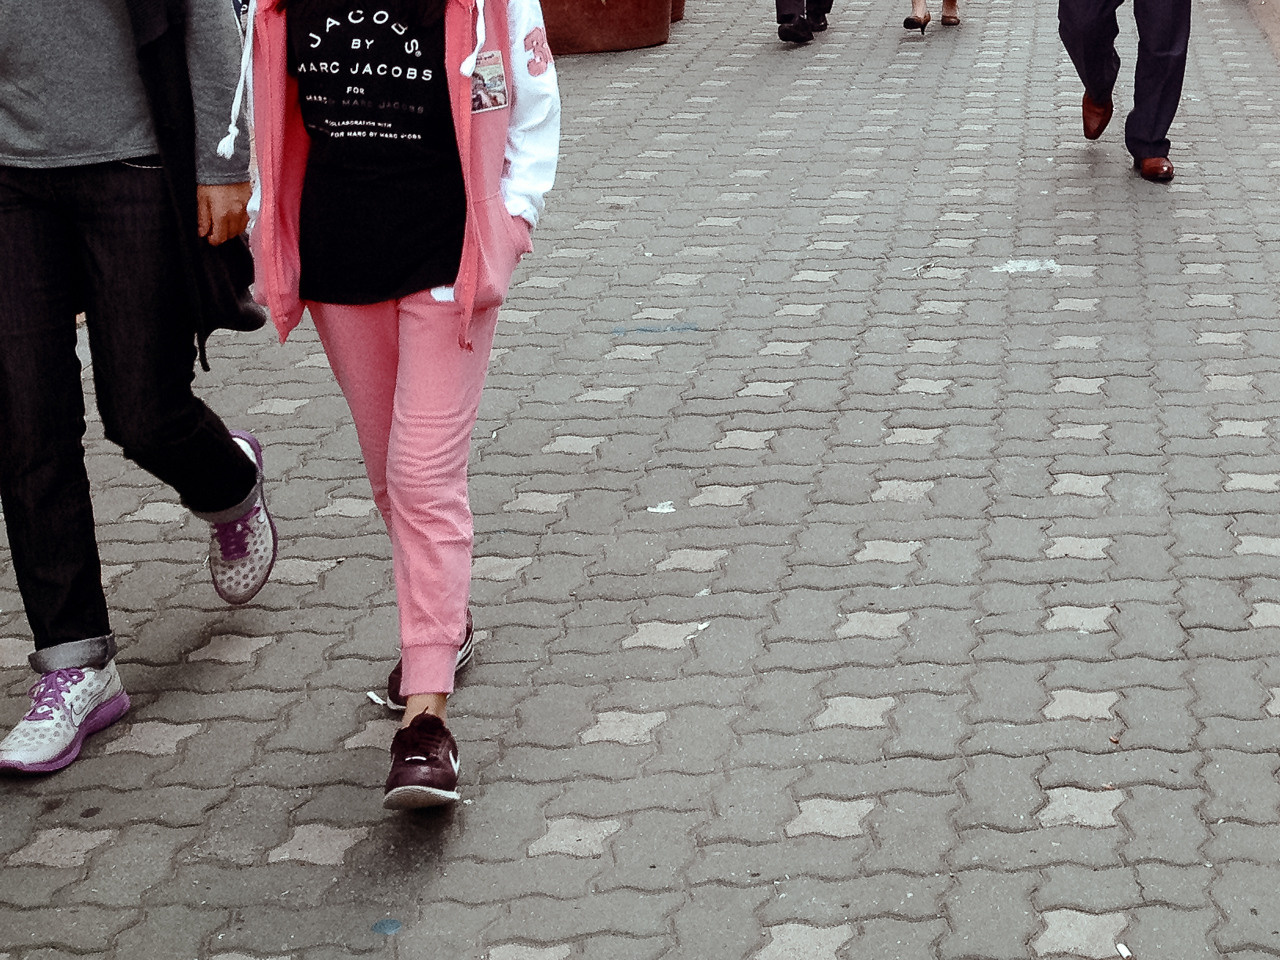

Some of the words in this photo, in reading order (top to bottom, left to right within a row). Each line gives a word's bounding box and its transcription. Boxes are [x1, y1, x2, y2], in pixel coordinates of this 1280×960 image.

[351, 38, 374, 49] BY
[297, 61, 340, 74] MARC
[350, 63, 433, 81] JACOBS
[346, 86, 365, 95] FOR
